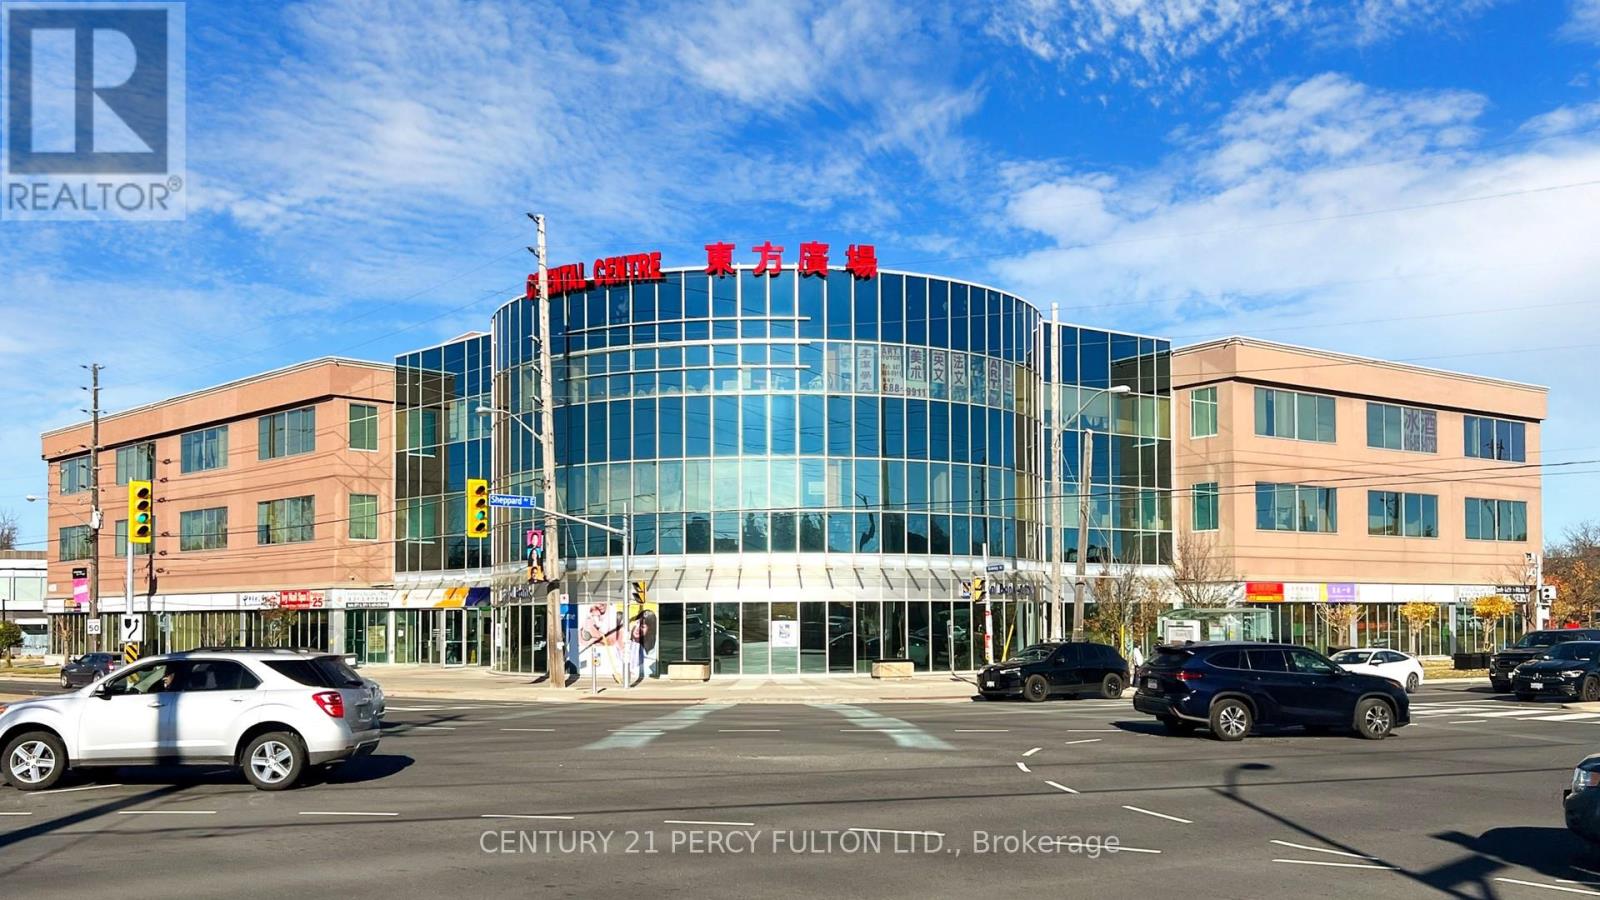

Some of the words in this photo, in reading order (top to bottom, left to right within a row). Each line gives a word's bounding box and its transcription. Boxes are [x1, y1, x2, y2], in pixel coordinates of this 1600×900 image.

[593, 251, 663, 286] CENTRE
[704, 241, 879, 279] 東方廣場
[953, 354, 965, 385] 法文
[490, 495, 523, 506] Sheppard
[530, 497, 535, 506] E
[312, 597, 323, 608] 25
[88, 624, 100, 632] 50
